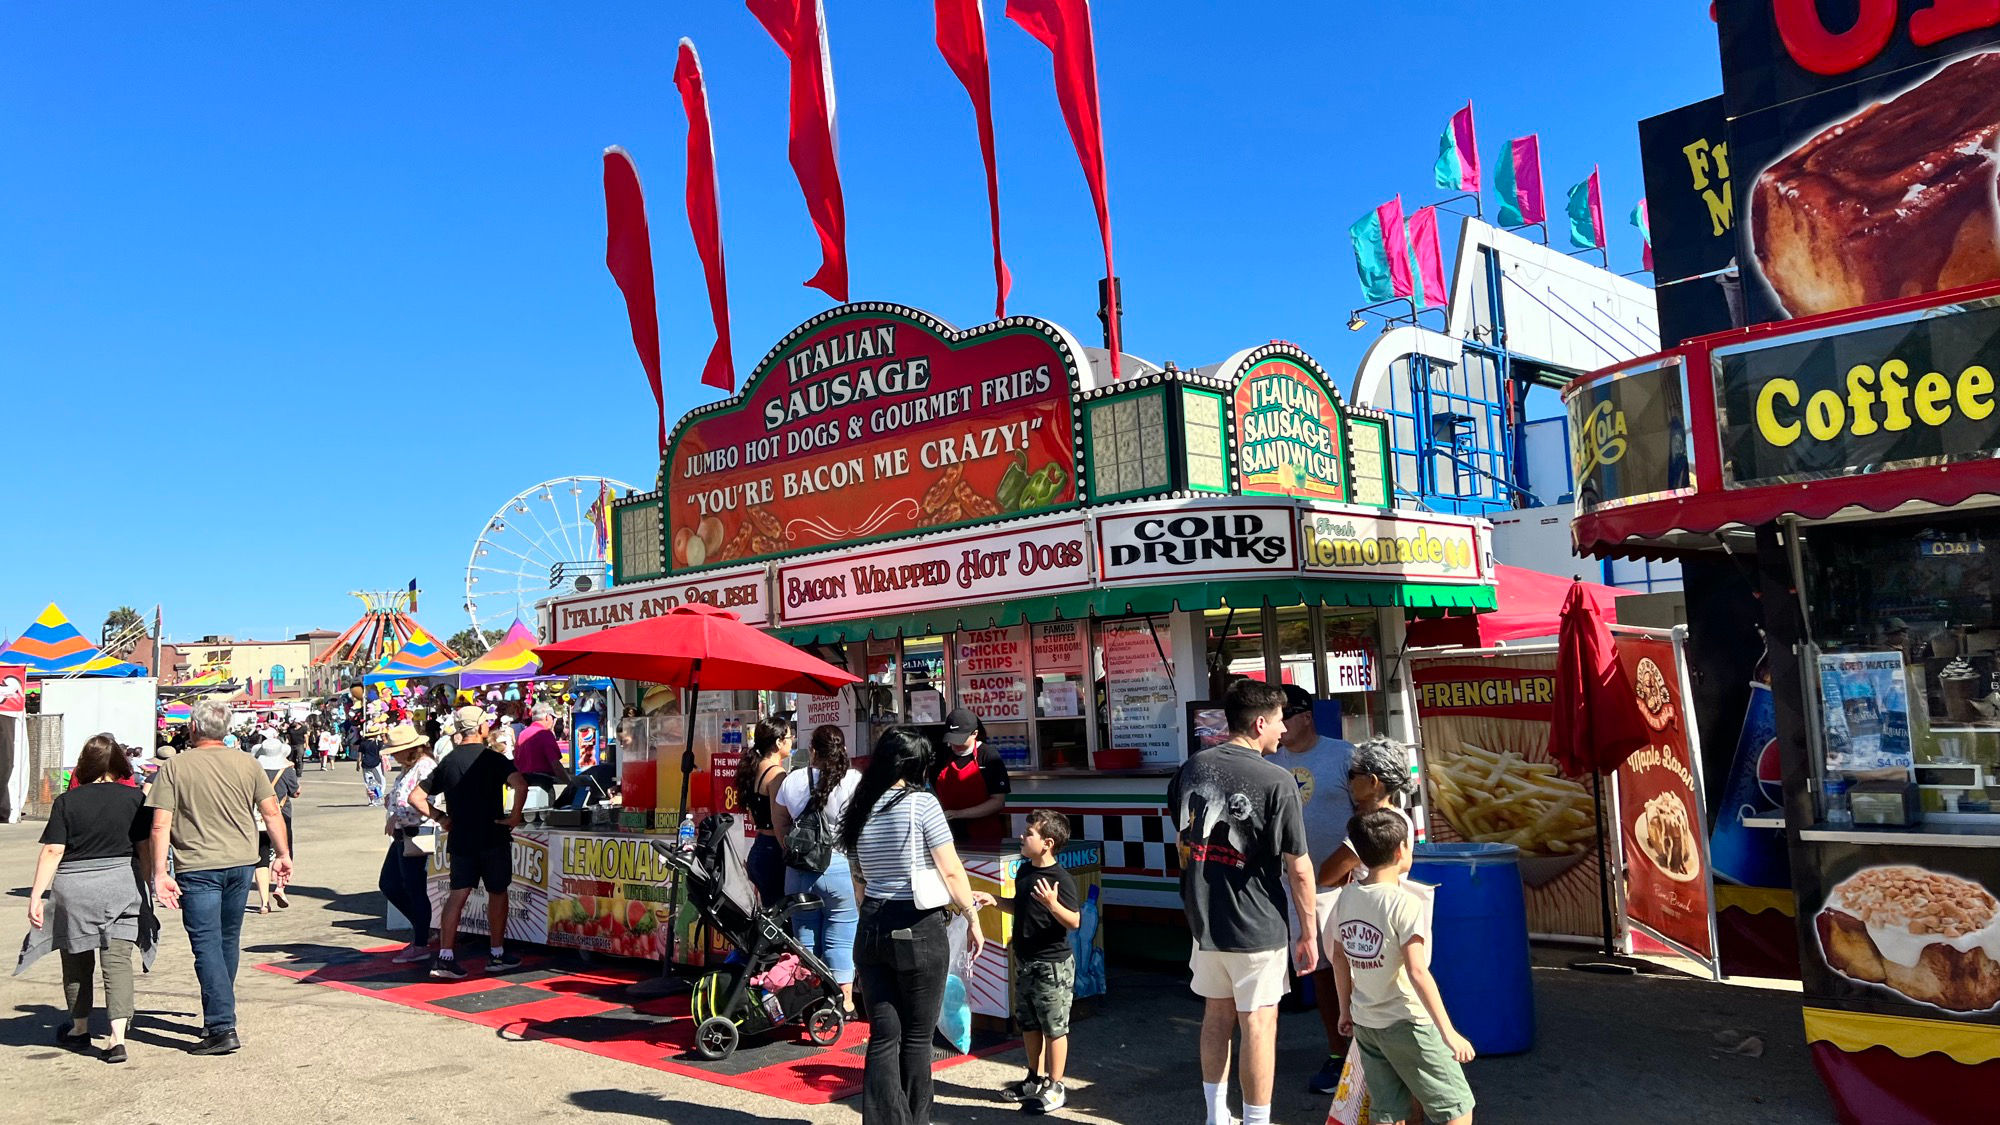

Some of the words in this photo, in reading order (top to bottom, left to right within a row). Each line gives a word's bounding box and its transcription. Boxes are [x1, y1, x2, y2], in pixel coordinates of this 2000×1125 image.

[787, 325, 896, 385] ITALIAN
[764, 359, 930, 431] SAUSAGE
[1250, 375, 1319, 420] ITALIAN
[1755, 358, 1996, 448] Coffee
[683, 446, 739, 479] JUMBO
[745, 435, 781, 465] HOT
[787, 424, 840, 456] DOGS
[847, 415, 864, 439] &
[871, 391, 972, 435] GOURMET
[981, 366, 1051, 408] FRIES
[1243, 411, 1332, 455] SAUSAGE
[783, 457, 865, 499] BACON
[873, 448, 911, 477] ME
[920, 417, 1044, 470] CRAZY!"
[1241, 441, 1340, 485] SANDWICH
[1134, 514, 1263, 541] COLD
[1315, 517, 1356, 539] Fresh
[1110, 536, 1287, 567] DRINKS
[1304, 526, 1444, 569] lemonade
[786, 574, 847, 609] BACON
[851, 557, 951, 595] WRAPPED
[956, 549, 1012, 591] HOT
[1017, 540, 1084, 577] DOGS
[561, 602, 634, 631] ITALIAN
[639, 595, 681, 619] AND
[684, 583, 758, 609] POLISH
[968, 629, 1009, 644] TASTY
[1043, 623, 1075, 634] FAMOUS
[1043, 632, 1076, 644] STUFFED
[961, 641, 1018, 658] CHICKEN
[968, 655, 1013, 671] STRIPS
[970, 676, 1014, 691] BACON
[1339, 664, 1372, 687] FRIES
[807, 701, 840, 713] WRAPPED
[962, 690, 1023, 704] WRAPPED
[1421, 679, 1515, 708] FRENCH
[808, 711, 840, 724] HOTDOGS
[968, 704, 1020, 719] HOTDOG
[714, 758, 727, 766] THE
[1626, 744, 1662, 774] Maple
[714, 769, 721, 777] IS
[511, 841, 543, 884] RIES
[1359, 927, 1380, 945] JON
